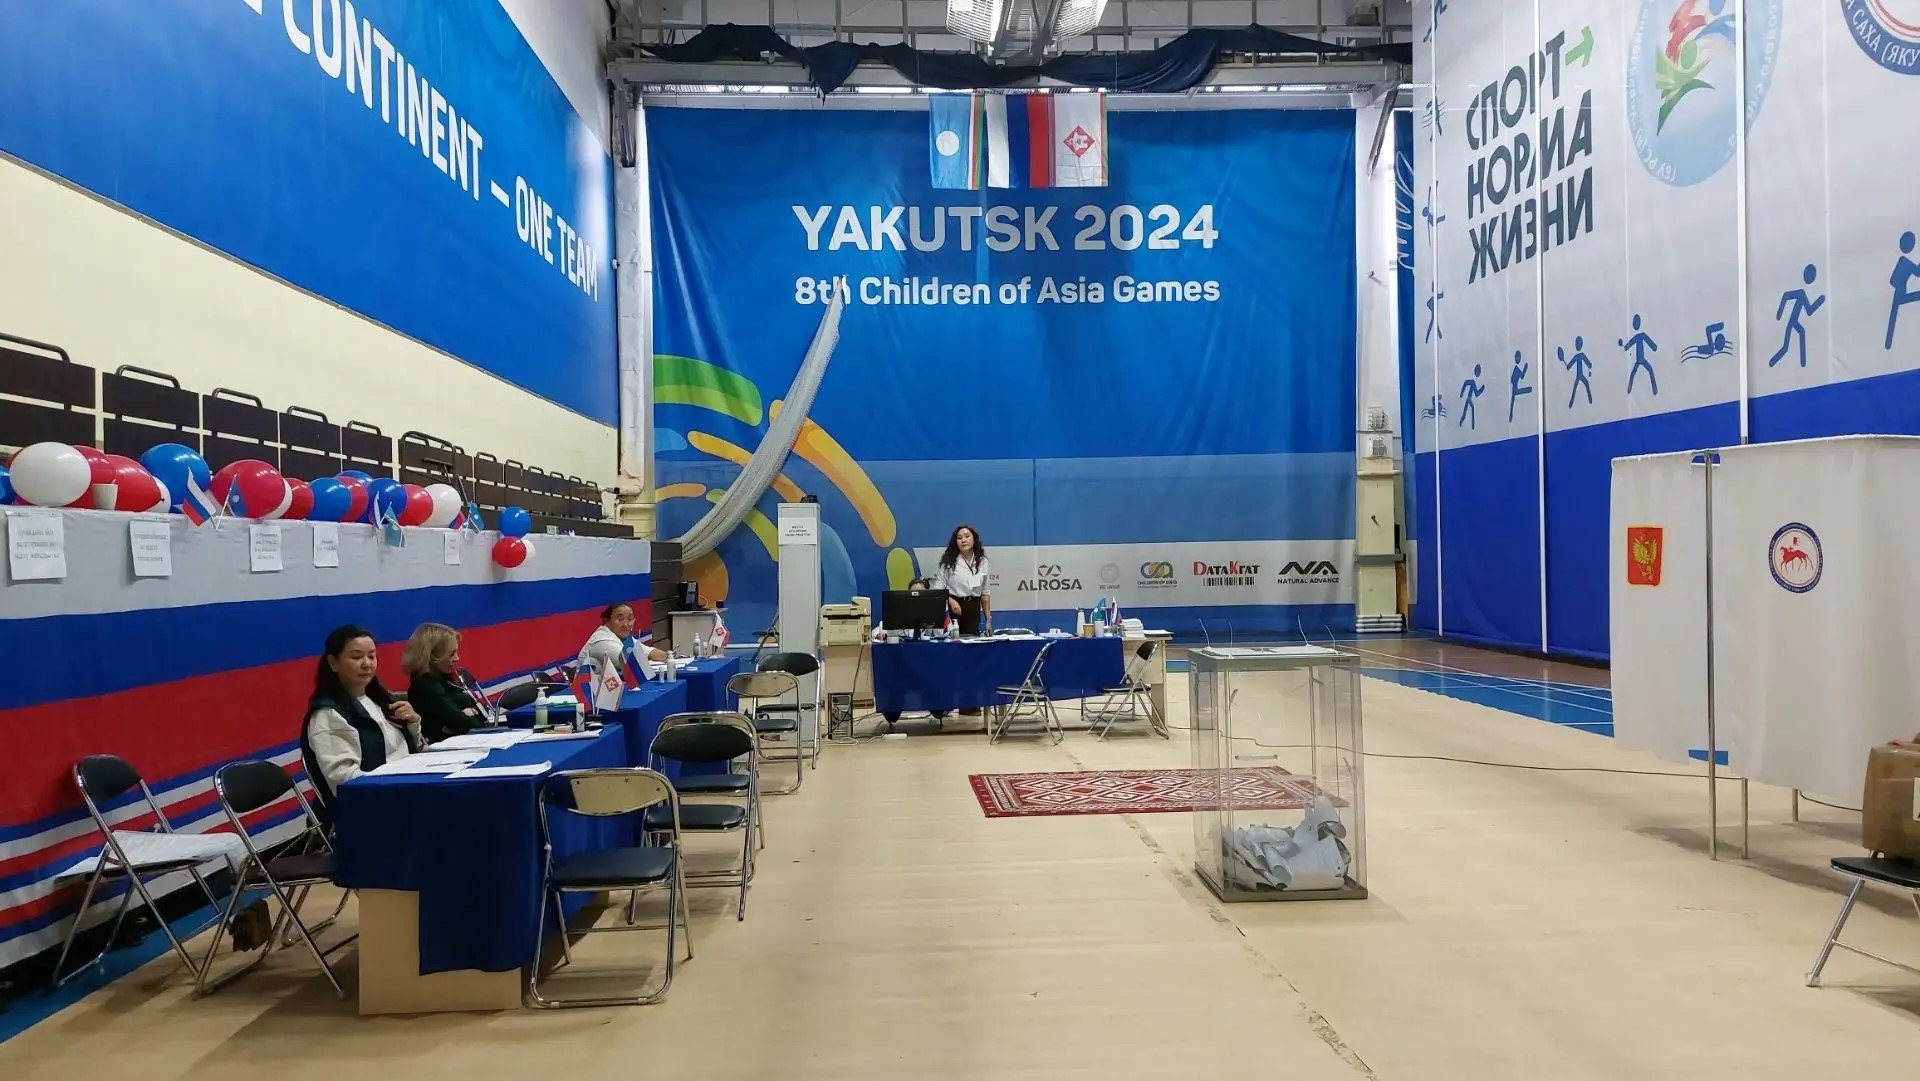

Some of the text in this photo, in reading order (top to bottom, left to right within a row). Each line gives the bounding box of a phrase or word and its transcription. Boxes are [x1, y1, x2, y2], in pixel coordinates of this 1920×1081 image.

[1852, 8, 1881, 52] САХА
[1466, 30, 1565, 150] СПОРТ
[1467, 89, 1592, 220] НОРМА
[515, 175, 554, 265] ONE
[556, 215, 598, 302] TEAM
[791, 204, 1219, 252] YAKUTSK 2024
[1468, 165, 1593, 285] ЖИЗНИ
[795, 275, 1221, 305] 8th Children of Asia Games
[1017, 578, 1083, 592] ALROSA
[1277, 576, 1340, 585] NATURAL ADVANCE
